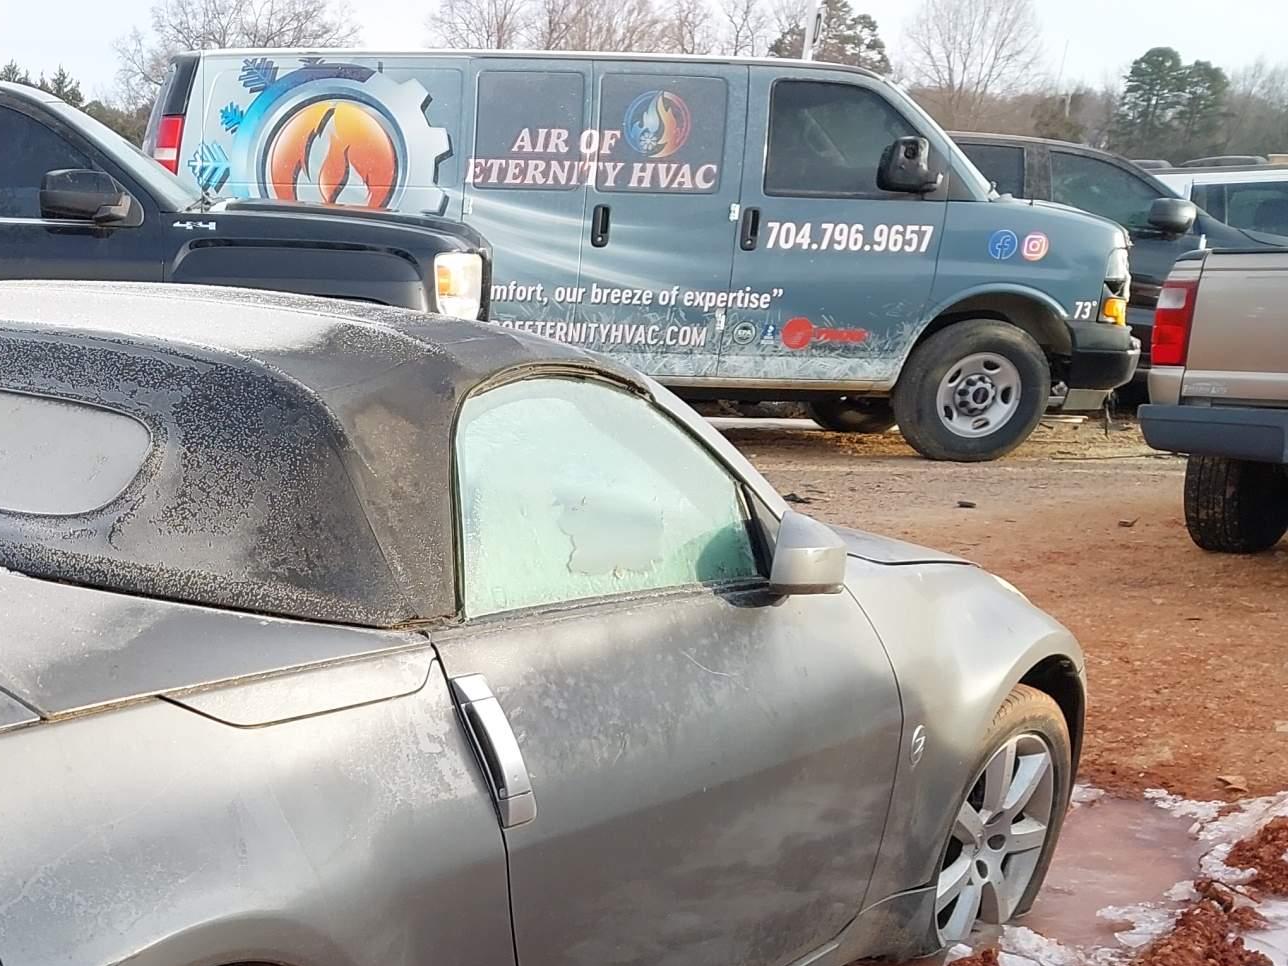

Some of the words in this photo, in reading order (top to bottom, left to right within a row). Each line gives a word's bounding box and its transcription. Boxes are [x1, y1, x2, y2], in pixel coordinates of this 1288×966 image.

[512, 127, 569, 154] AIR
[579, 128, 622, 155] OF
[464, 158, 625, 188] ETERNITY
[627, 162, 718, 190] HVAC
[765, 221, 935, 254] 704.796.9657
[554, 285, 586, 304] our
[590, 282, 653, 306] breeze
[658, 284, 680, 307] of
[488, 319, 708, 347] ETERNITYHVAC.COM
